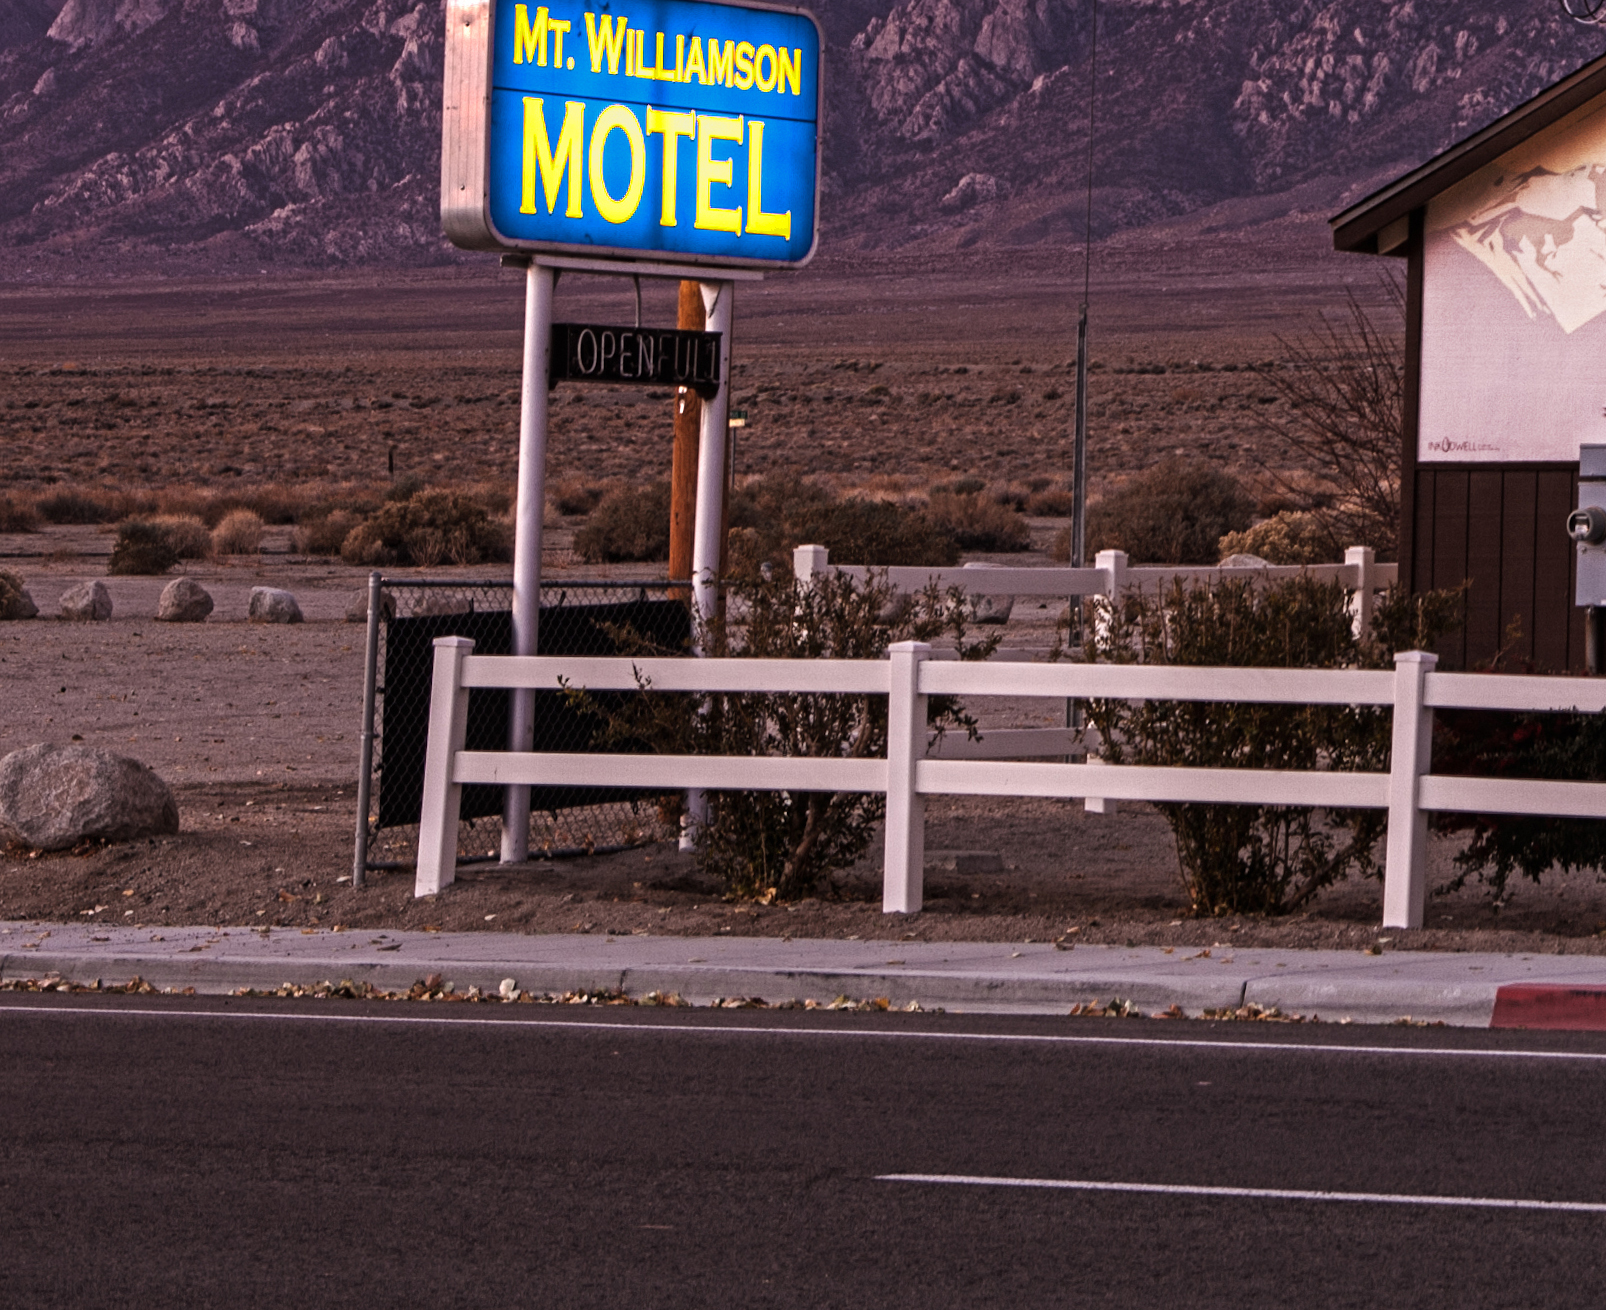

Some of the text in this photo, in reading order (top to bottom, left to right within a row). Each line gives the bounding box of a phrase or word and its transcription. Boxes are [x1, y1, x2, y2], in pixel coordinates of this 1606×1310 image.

[584, 11, 803, 96] WILLIAMSON
[519, 96, 792, 242] MOTEL
[577, 328, 655, 378] OPEN
